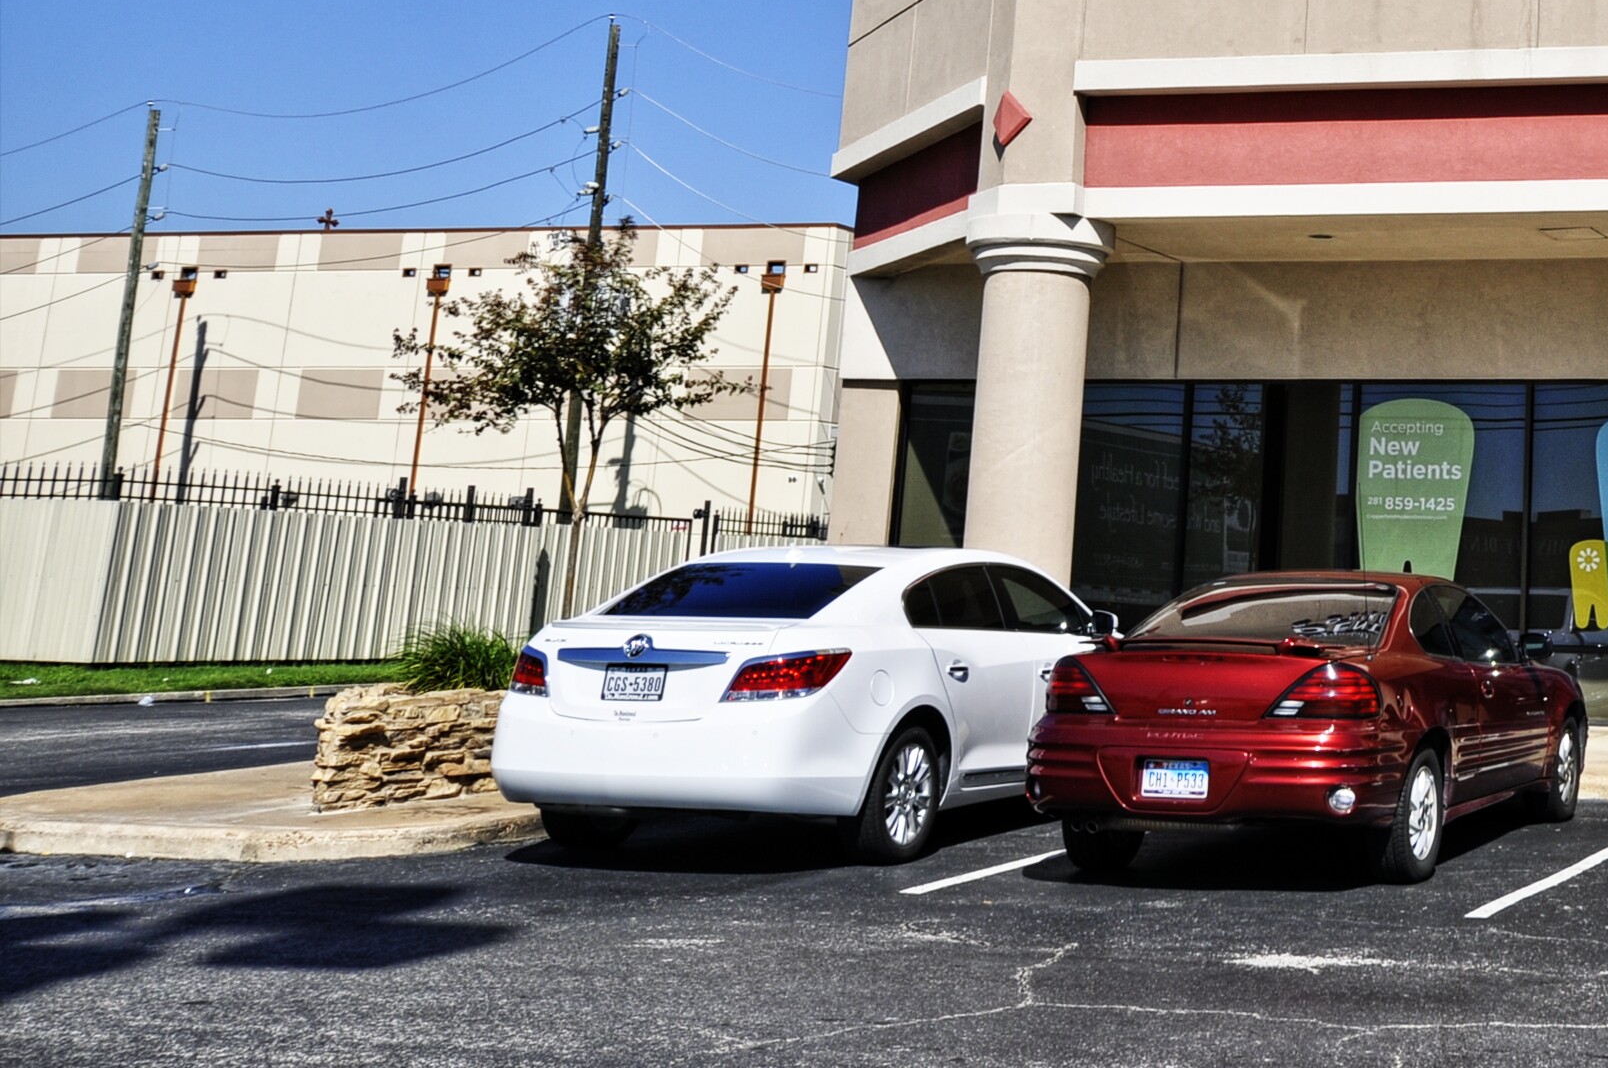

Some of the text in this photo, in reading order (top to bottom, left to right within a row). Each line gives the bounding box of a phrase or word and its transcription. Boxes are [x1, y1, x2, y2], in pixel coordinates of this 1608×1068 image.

[1371, 421, 1444, 436] Accepting
[1369, 437, 1420, 455] New
[1368, 460, 1462, 479] Patients
[1367, 496, 1455, 511] 281 859-1425
[1162, 762, 1190, 770] TEXAS
